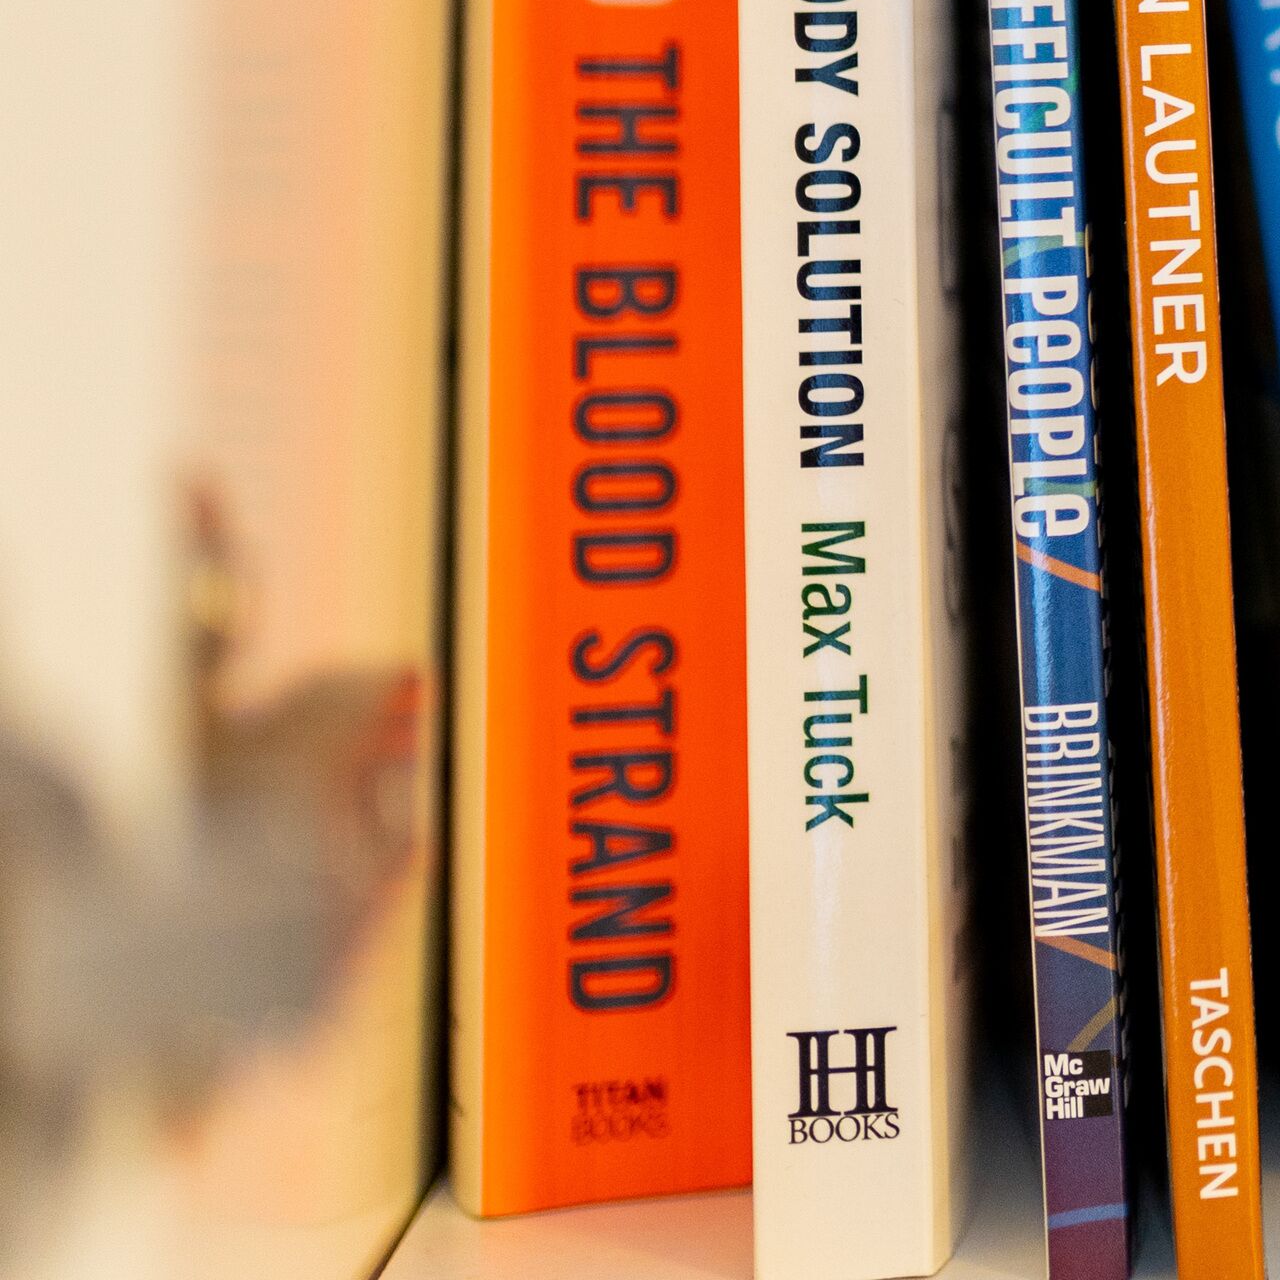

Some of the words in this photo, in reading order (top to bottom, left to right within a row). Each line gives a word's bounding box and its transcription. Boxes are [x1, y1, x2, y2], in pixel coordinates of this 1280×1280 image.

[574, 40, 682, 223] THE
[1141, 43, 1208, 388] LAUTNER
[793, 123, 865, 469] SOLUTION
[570, 262, 681, 584] BLOOD
[800, 521, 866, 658] Max
[567, 625, 680, 1013] STRAND
[803, 675, 870, 832] Tuck
[1021, 701, 1109, 938] BRINKMAN
[788, 1113, 900, 1144] BOOKS
[1044, 1053, 1083, 1076] Mc
[1045, 1076, 1110, 1098] Graw
[1046, 1097, 1084, 1120] Hill
[1189, 968, 1239, 1199] TASCHEN
